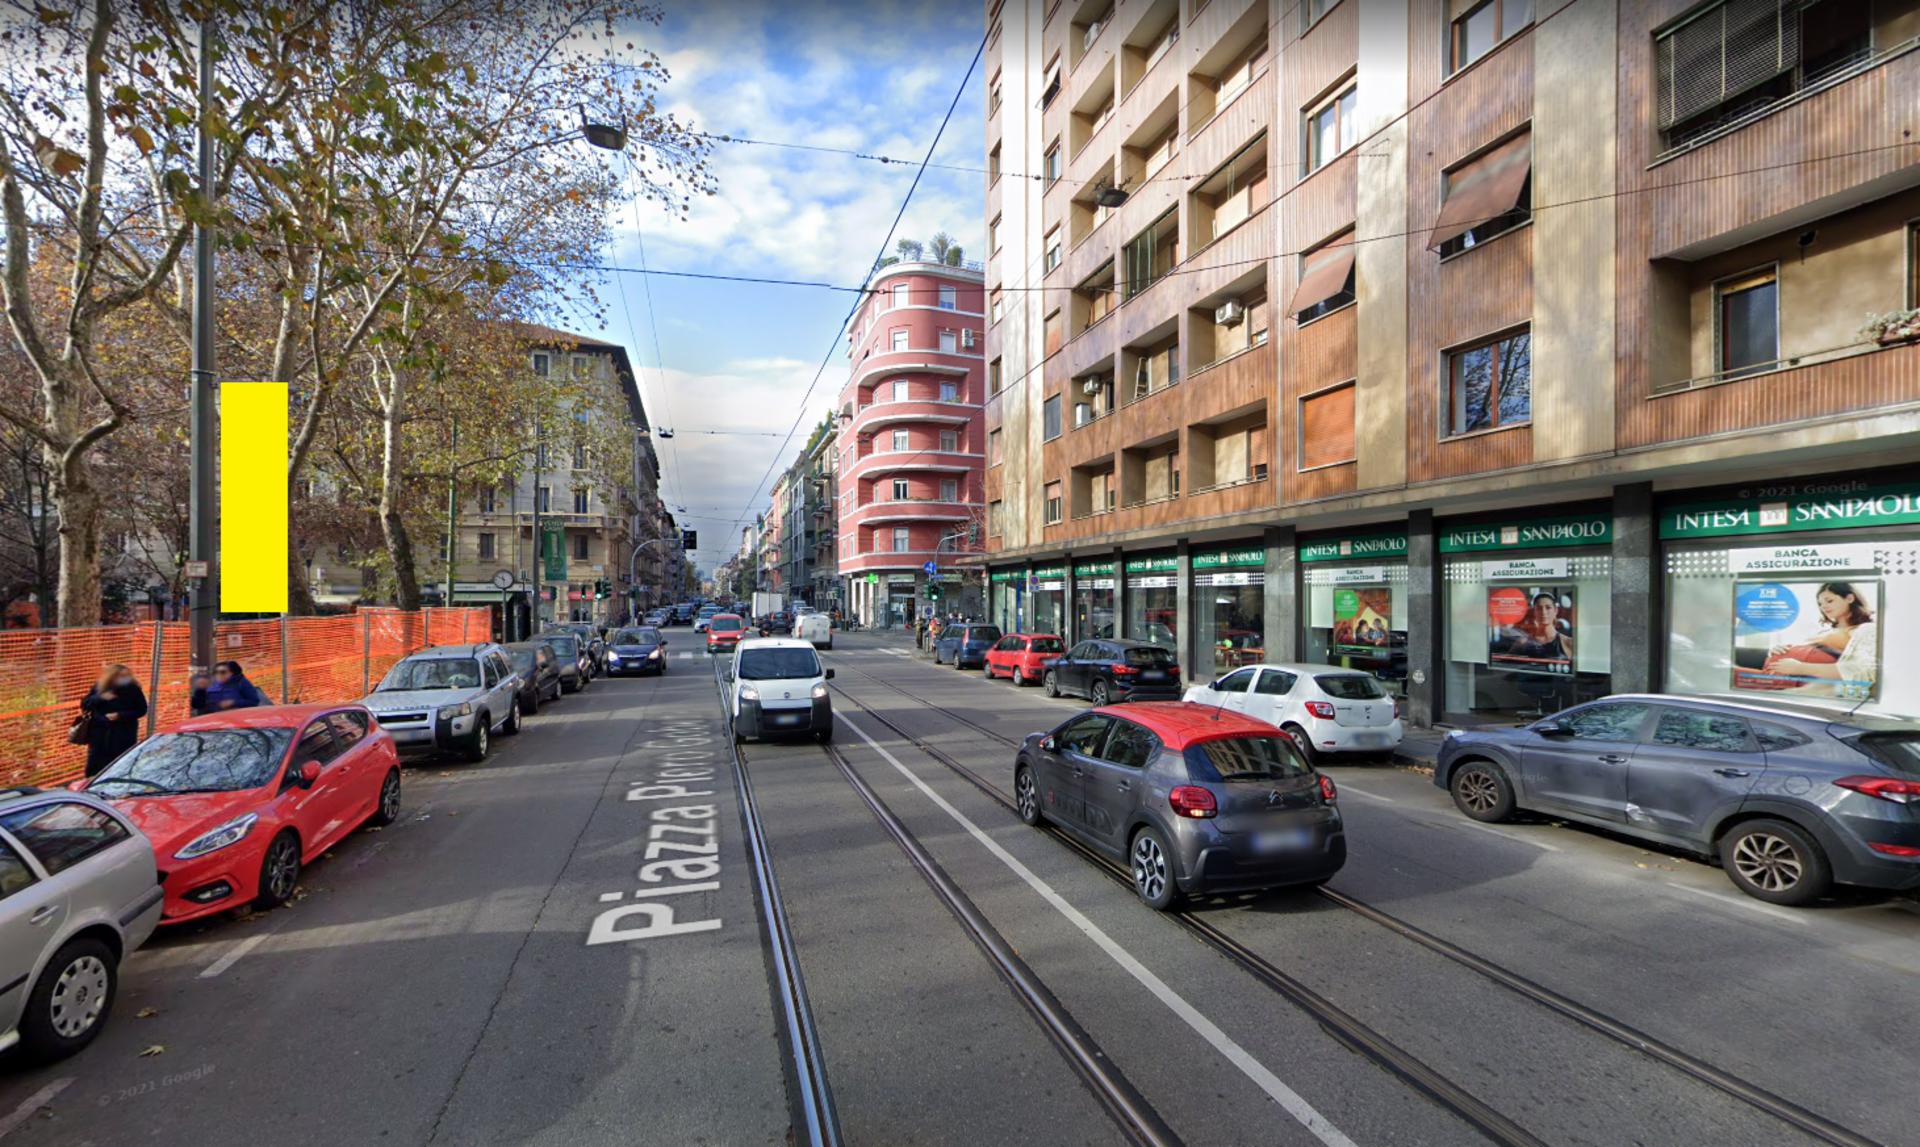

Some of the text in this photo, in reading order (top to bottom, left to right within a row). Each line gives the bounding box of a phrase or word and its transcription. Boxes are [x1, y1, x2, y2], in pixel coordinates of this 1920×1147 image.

[1676, 494, 1920, 531] INTESA SANPAOL
[1450, 520, 1606, 546] INTESA SANPAOLO
[1746, 557, 1850, 569] ASSICURAZIONE
[1775, 549, 1818, 558] BANCA
[586, 804, 722, 945] Piazza
